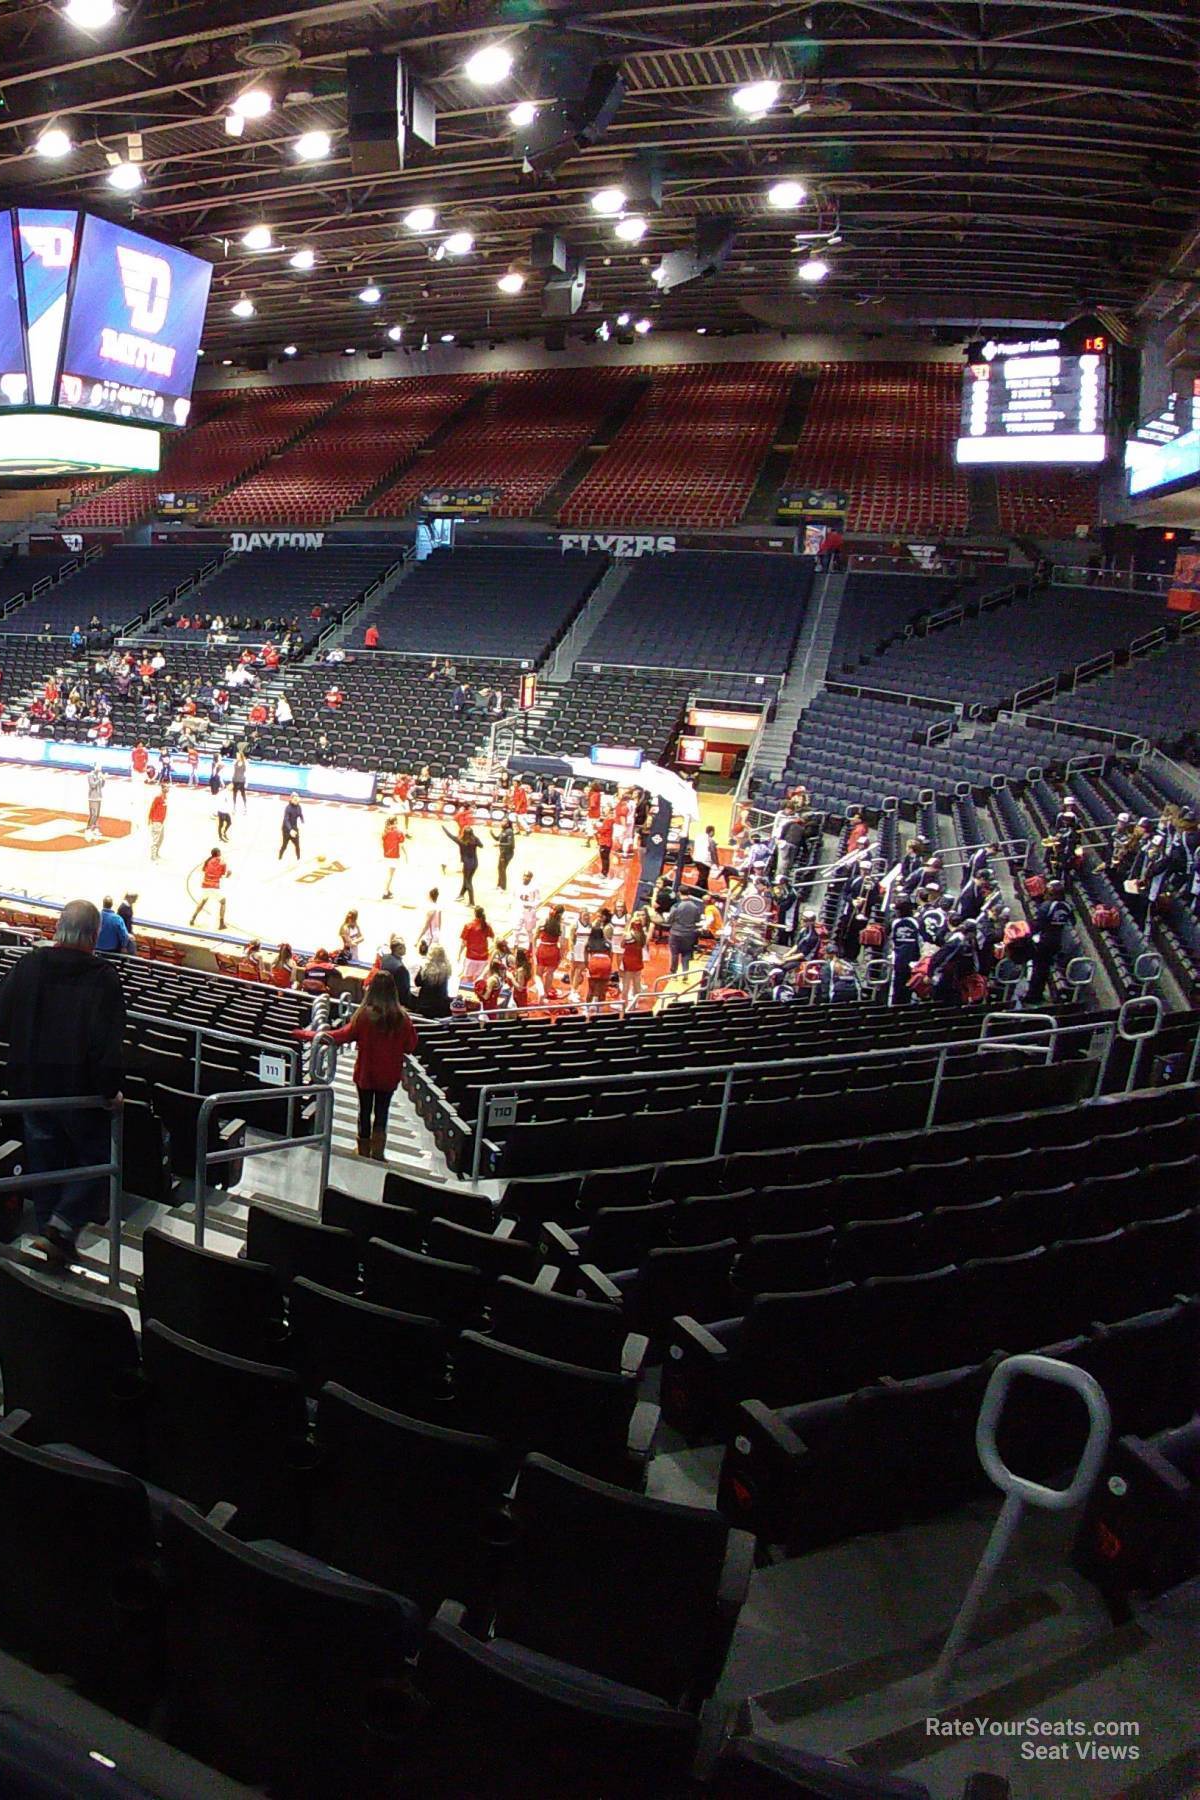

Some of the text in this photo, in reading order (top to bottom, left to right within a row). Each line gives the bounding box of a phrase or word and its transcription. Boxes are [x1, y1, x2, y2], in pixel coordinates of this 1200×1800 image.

[100, 329, 177, 377] DAYTON
[230, 533, 324, 552] DAYTON
[559, 535, 676, 557] FLYERS
[266, 1065, 279, 1076] 111
[494, 1106, 512, 1118] 110
